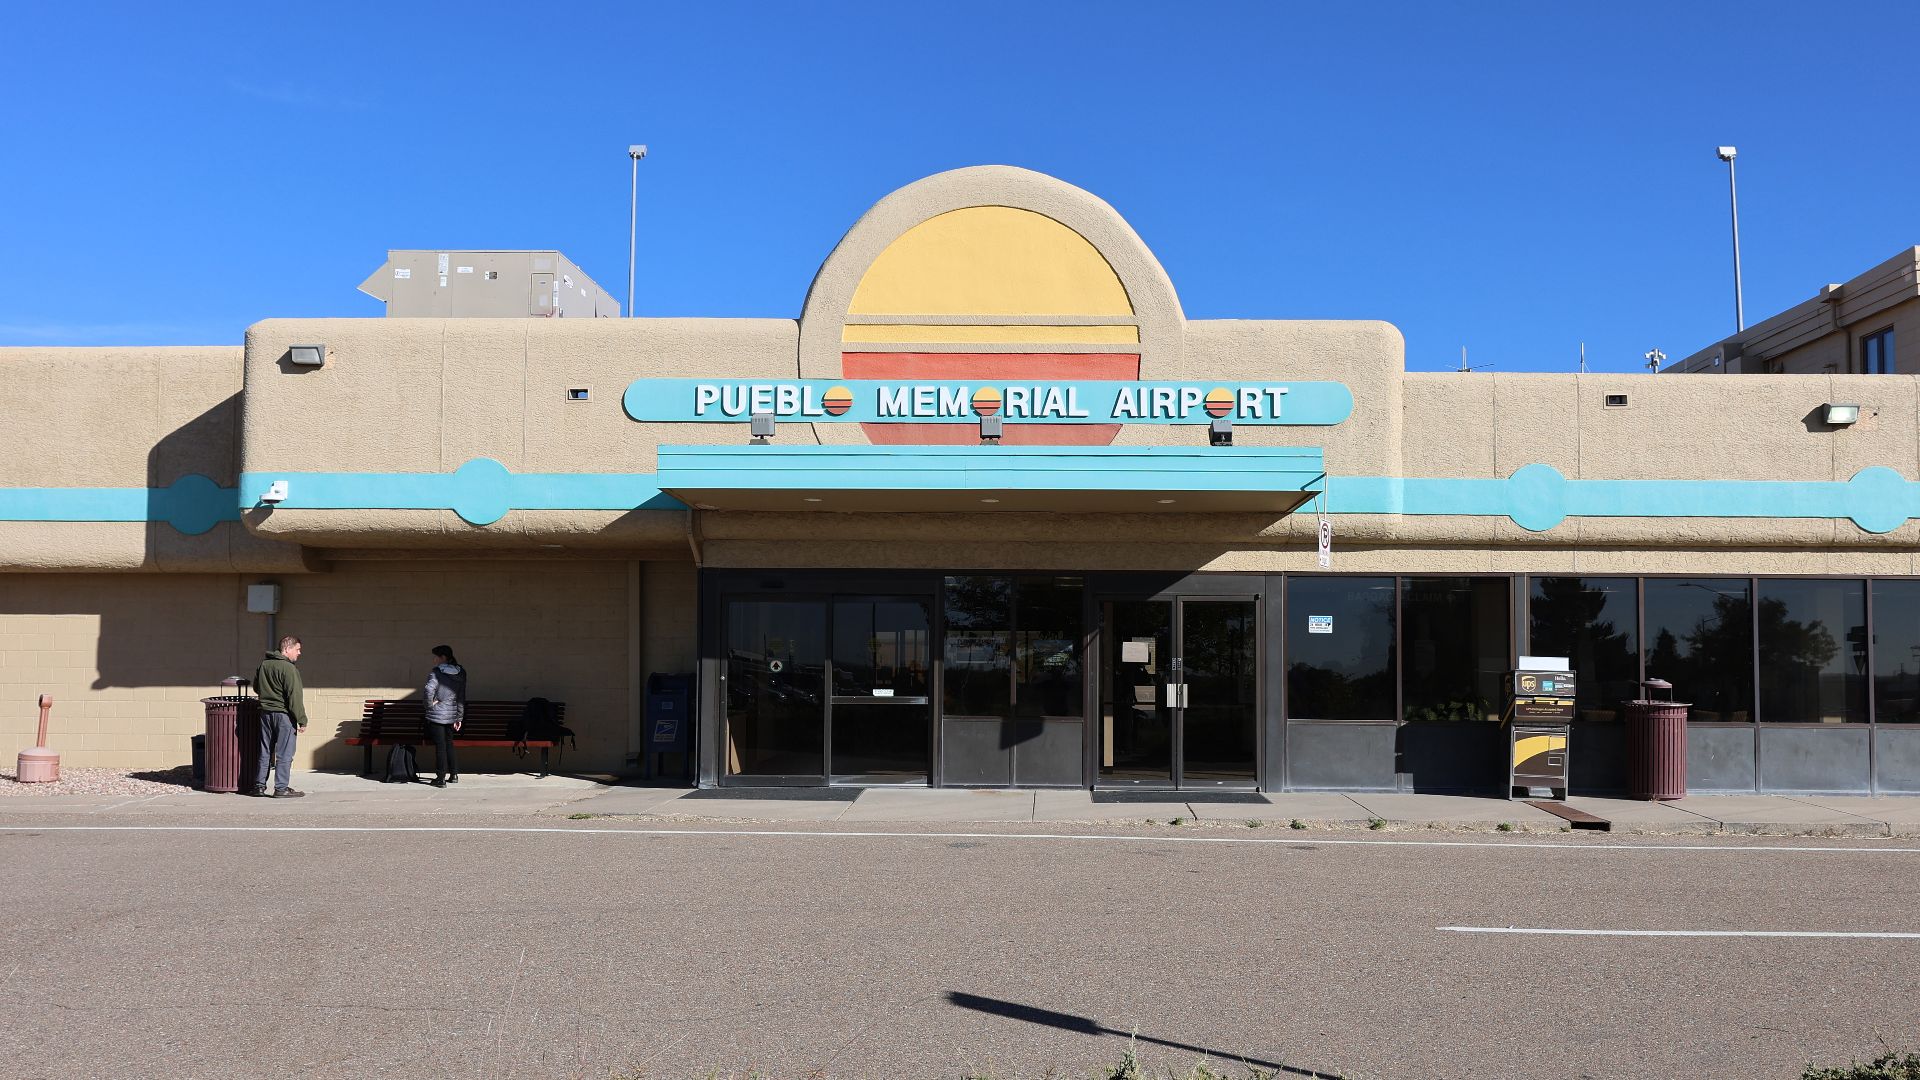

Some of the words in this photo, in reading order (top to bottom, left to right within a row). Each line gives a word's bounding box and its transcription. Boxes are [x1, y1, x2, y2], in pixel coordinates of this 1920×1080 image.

[695, 384, 854, 417] PUEBLO
[879, 385, 1090, 418] MEMORIAL
[1111, 386, 1289, 418] AIRPORT
